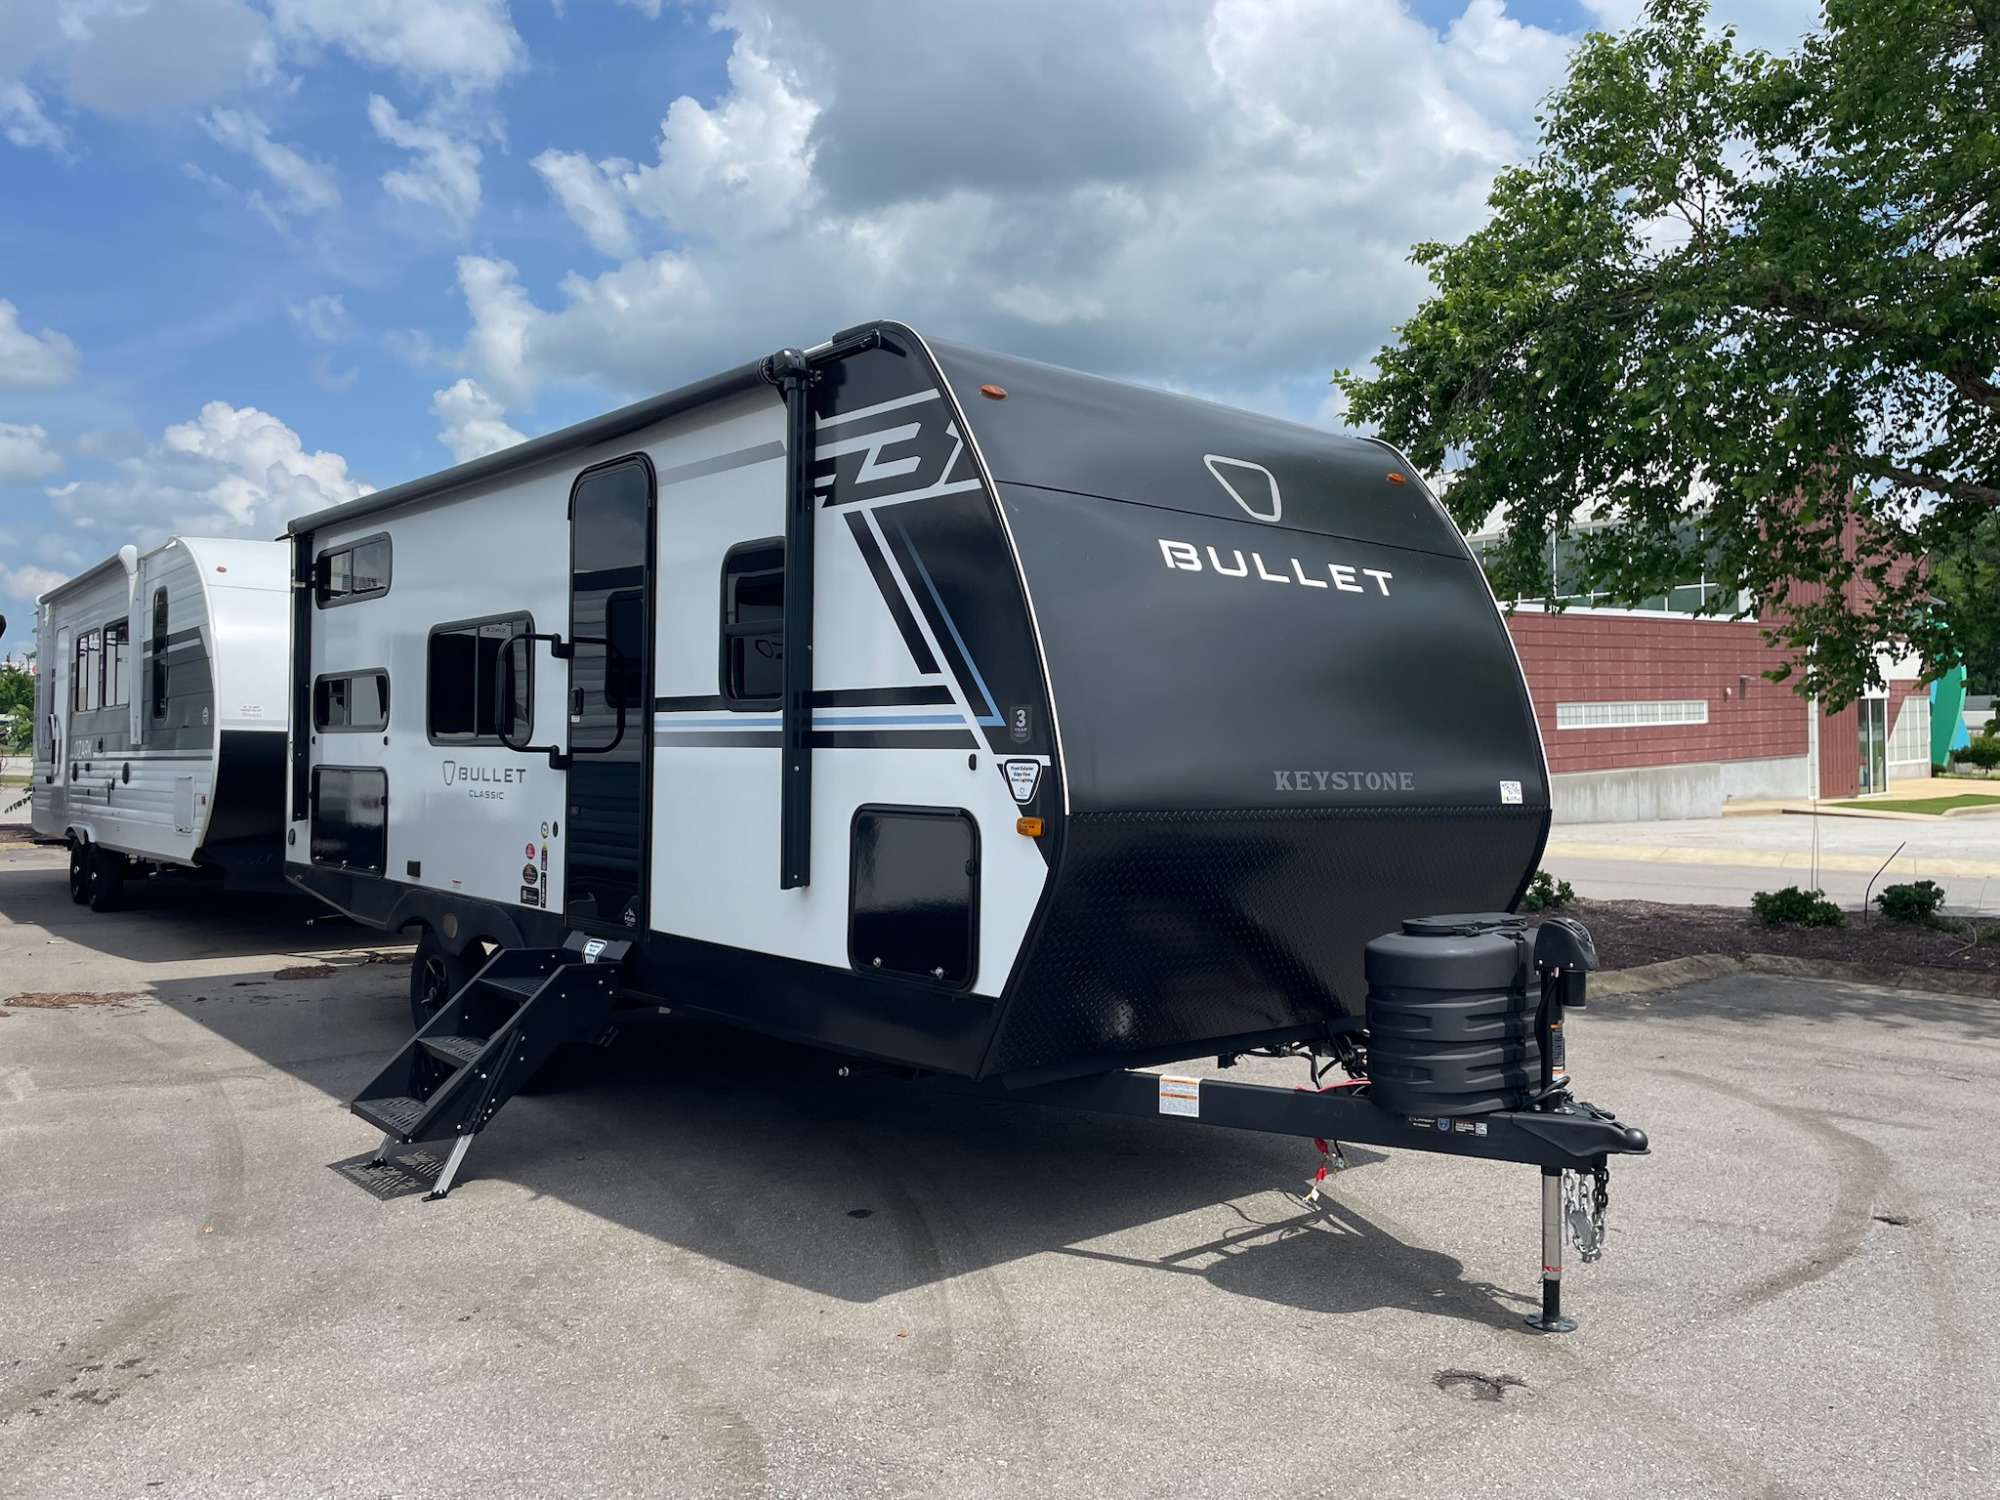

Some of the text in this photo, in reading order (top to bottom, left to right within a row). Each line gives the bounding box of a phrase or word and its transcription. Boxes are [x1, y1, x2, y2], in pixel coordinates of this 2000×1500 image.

[1157, 538, 1394, 597] BULLET
[1016, 709, 1026, 727] 3
[73, 739, 94, 760] OZARK
[458, 766, 527, 784] BULLET
[1273, 770, 1415, 791] KEYSTONE
[468, 789, 504, 800] CLASSIC
